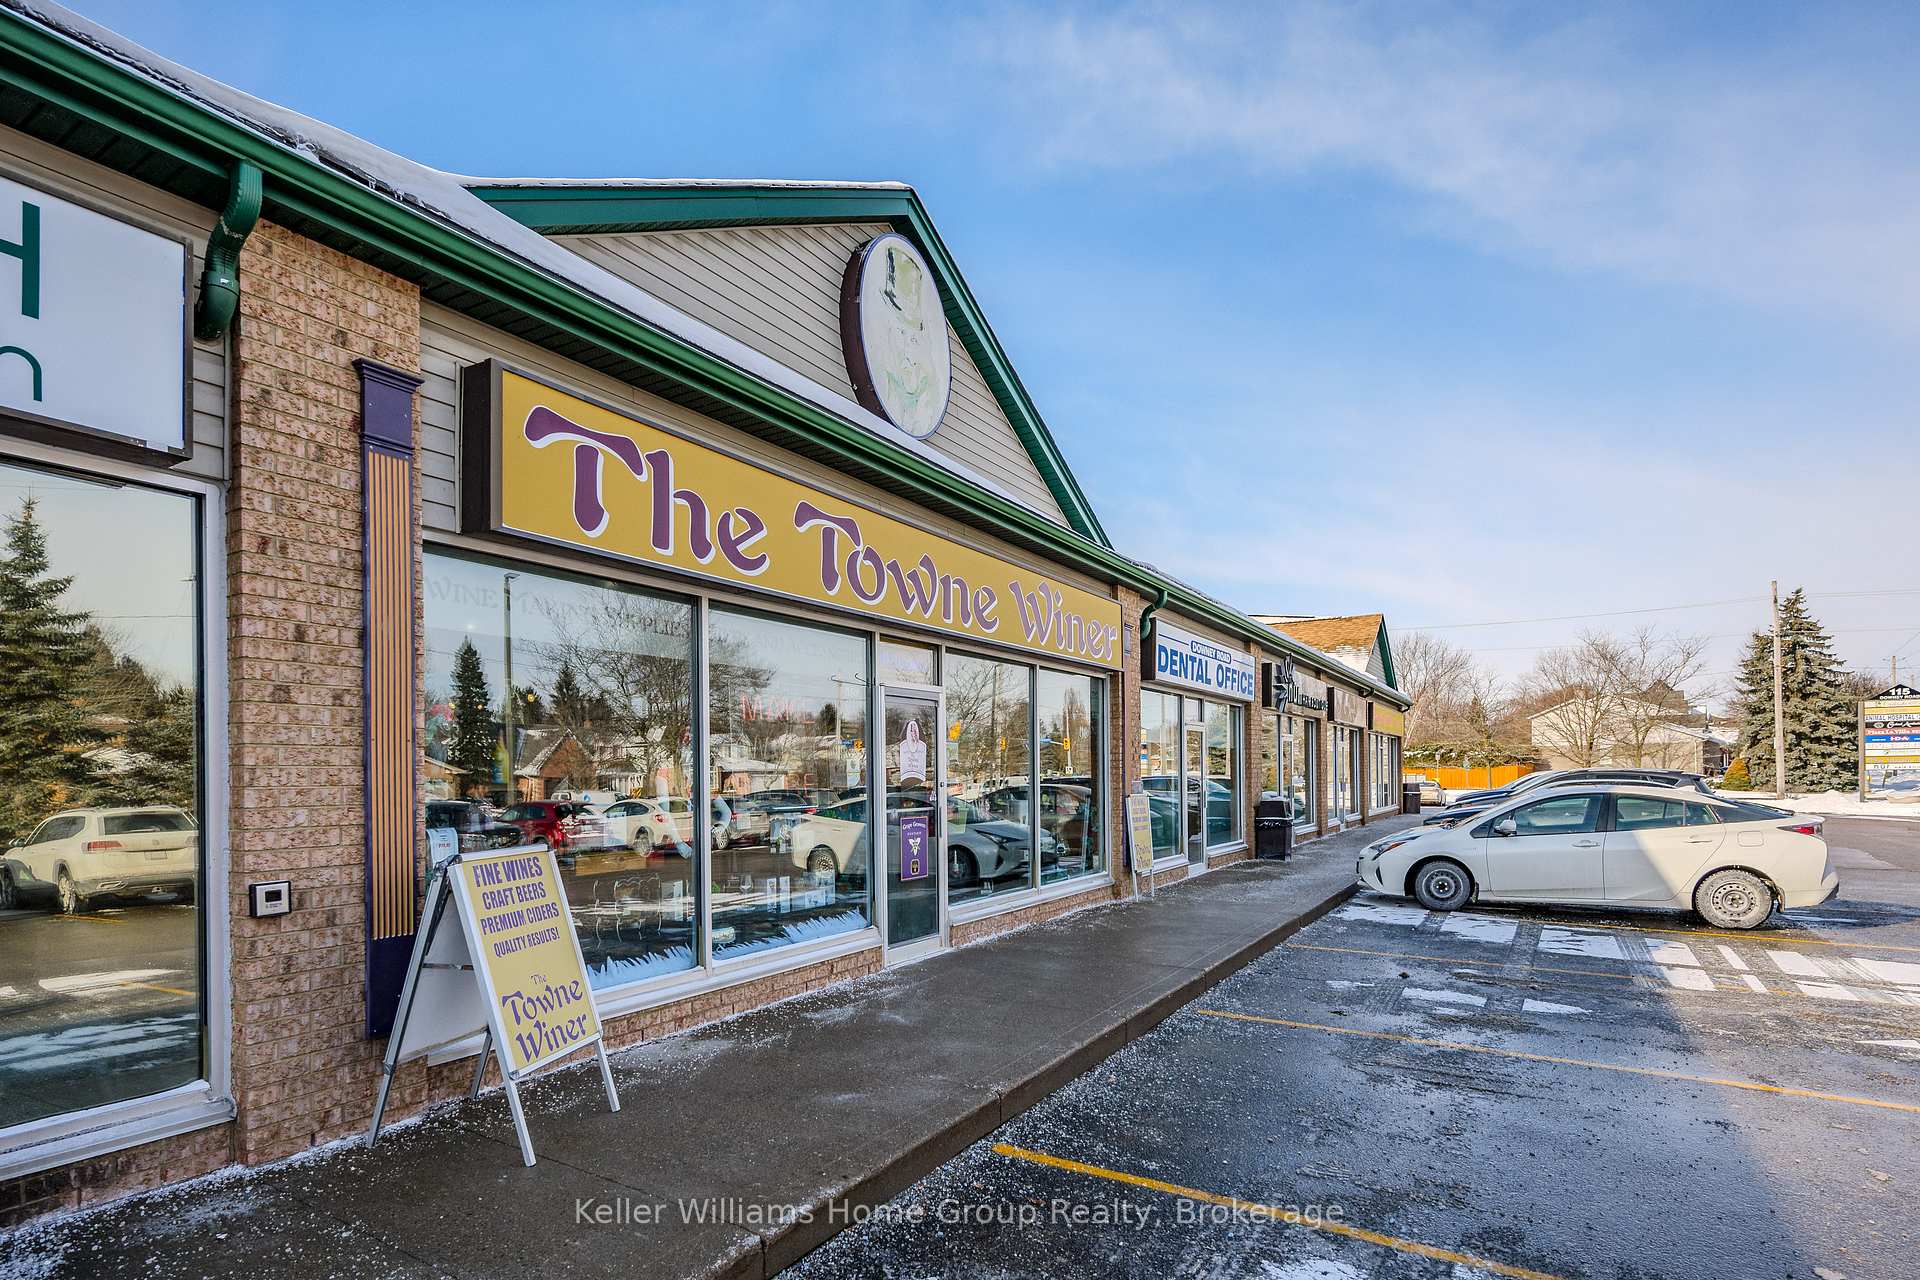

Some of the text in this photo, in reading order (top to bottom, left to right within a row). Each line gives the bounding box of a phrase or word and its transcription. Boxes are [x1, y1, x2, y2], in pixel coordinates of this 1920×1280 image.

[524, 404, 1118, 661] The Towne Winer
[1191, 642, 1231, 663] DOWNEY ROAD
[1157, 643, 1212, 686] DENTAL
[1216, 663, 1254, 696] OFFICE
[1889, 687, 1911, 696] 115
[472, 856, 543, 888] FINE WINES
[482, 881, 547, 910] CRAFT BEERS
[480, 902, 560, 935] PREMIUM CIDERS
[493, 926, 561, 958] QUALITY RESULTS!
[530, 974, 547, 985] The
[502, 979, 584, 1026] Towne
[515, 1013, 588, 1063] Winer
